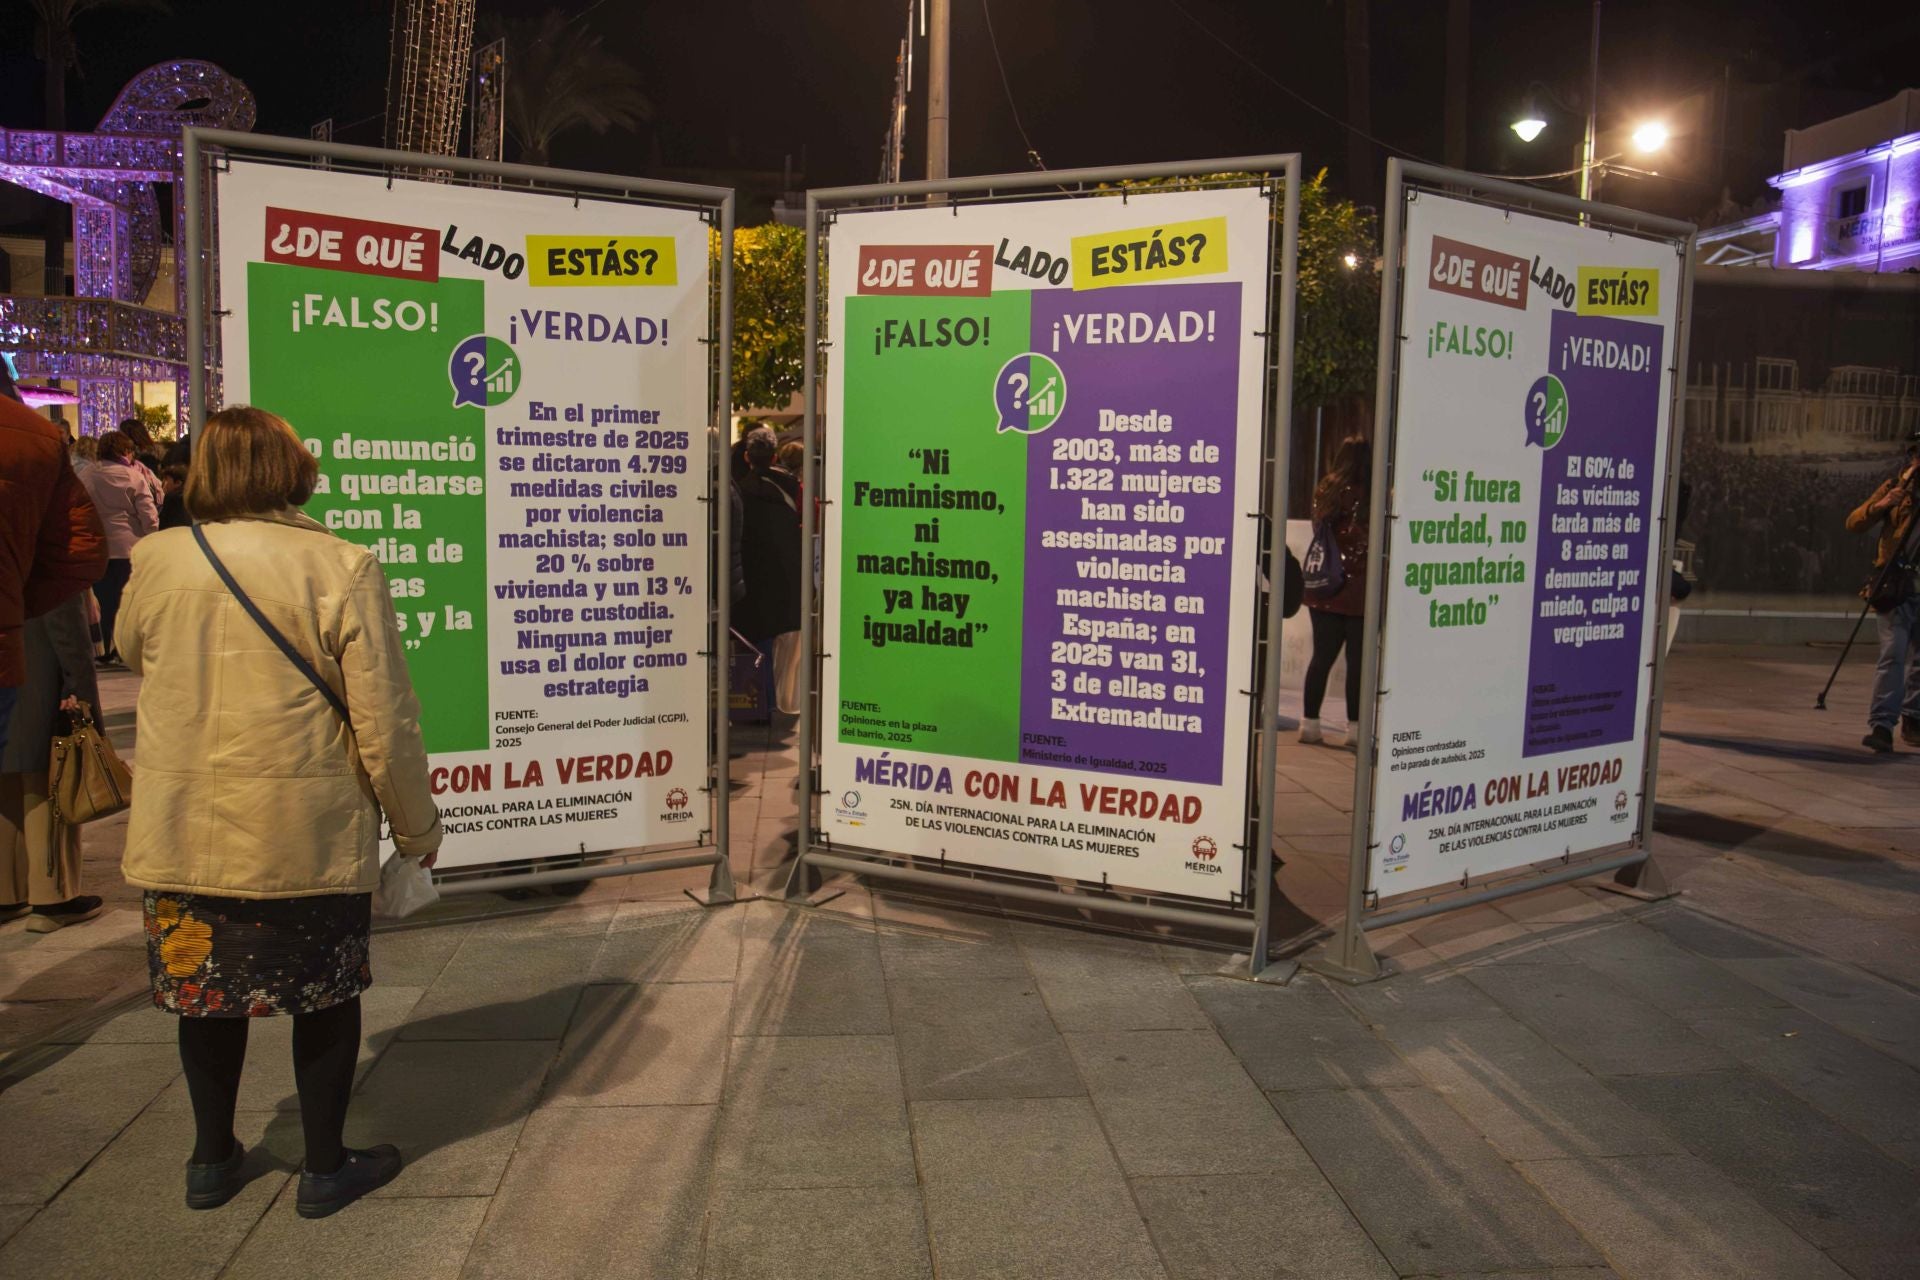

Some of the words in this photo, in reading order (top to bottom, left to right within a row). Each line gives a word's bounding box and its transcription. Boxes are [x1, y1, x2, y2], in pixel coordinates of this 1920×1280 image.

[271, 223, 343, 261] ¿DE
[356, 232, 424, 272] QUÉ
[441, 224, 524, 280] LADO
[548, 240, 658, 276] ESTÁS?
[862, 259, 916, 287] ¿DE
[925, 250, 980, 288] QUÉ
[994, 237, 1069, 286] LADO
[1091, 229, 1207, 277] ESTÁS?
[1433, 252, 1476, 289] ¿DE
[1481, 262, 1521, 300] QUÉ
[1530, 255, 1576, 309] LADO
[1588, 271, 1649, 306] ESTÁS?
[292, 294, 438, 332] ¡FALSO!
[510, 309, 668, 346] ¡VERDAD!
[875, 317, 990, 355] ¡FALSO!
[1053, 310, 1215, 352] ¡VERDAD!
[1428, 321, 1513, 360] ¡FALSO!
[1562, 336, 1651, 373] ¡VERDAD!
[529, 401, 557, 421] En
[564, 403, 584, 422] el
[591, 404, 660, 427] primer
[1098, 409, 1172, 432] Desde
[333, 432, 476, 461] denunció
[496, 426, 597, 448] trimestre
[603, 429, 629, 448] de
[635, 430, 689, 450] 2025
[1052, 438, 1121, 464] 2003,
[1129, 439, 1181, 462] más
[1189, 440, 1219, 463] de
[499, 456, 525, 472] se
[532, 452, 621, 473] dictaron
[627, 454, 687, 474] 4.799
[909, 448, 950, 475] “Ni
[1566, 455, 1582, 478] El
[1584, 456, 1615, 479] 60%
[1618, 458, 1635, 480] de
[341, 469, 484, 502] quedarse
[510, 478, 603, 498] medidas
[610, 479, 678, 499] civiles
[1050, 467, 1114, 491] 1.322
[1121, 469, 1221, 498] mujeres
[1422, 470, 1458, 502] “Si
[1464, 471, 1521, 503] fuera
[1556, 483, 1579, 506] las
[1582, 484, 1640, 506] víctimas
[854, 481, 1004, 515] Feminismo,
[1081, 497, 1126, 521] han
[1133, 499, 1185, 523] sido
[325, 508, 384, 531] con
[393, 503, 422, 529] la
[526, 508, 561, 527] por
[568, 504, 664, 523] violencia
[1552, 512, 1589, 534] tarda
[1592, 512, 1622, 533] más
[1624, 512, 1641, 533] de
[498, 528, 606, 550] machista;
[613, 528, 656, 547] solo
[662, 532, 688, 547] un
[914, 517, 939, 543] ni
[1041, 527, 1177, 553] asesinadas
[1184, 536, 1225, 559] por
[1409, 513, 1492, 548] verdad,
[1500, 520, 1527, 543] no
[536, 554, 565, 573] 20
[572, 554, 591, 573] %
[597, 554, 654, 572] sobre
[1561, 539, 1572, 561] 8
[1575, 540, 1609, 560] años
[1612, 544, 1629, 560] en
[856, 551, 998, 584] machismo,
[1076, 556, 1186, 583] violencia
[1404, 553, 1525, 594] aguantaría
[1545, 566, 1615, 589] denunciar
[1617, 570, 1640, 591] por
[494, 579, 588, 599] vivienda
[594, 583, 607, 601] y
[613, 582, 640, 596] un
[647, 576, 668, 596] 13
[674, 576, 692, 595] %
[883, 589, 913, 614] ya
[921, 585, 970, 619] hay
[1056, 586, 1166, 612] machista
[1174, 595, 1204, 614] en
[514, 604, 574, 624] sobre
[581, 601, 674, 622] custodia.
[1429, 594, 1499, 628] tanto”
[1540, 594, 1587, 618] miedo,
[1591, 592, 1628, 618] culpa
[1631, 596, 1640, 612] o
[517, 630, 607, 653] Ninguna
[614, 625, 673, 649] mujer
[863, 615, 988, 648] igualdad”
[1062, 613, 1157, 644] España;
[1165, 625, 1196, 644] en
[1554, 620, 1624, 648] vergüenza
[500, 659, 541, 675] usa
[547, 654, 567, 673] el
[574, 652, 626, 672] dolor
[633, 652, 687, 669] como
[1051, 641, 1112, 667] 2025
[1119, 651, 1164, 671] van
[1171, 649, 1205, 678] 31,
[544, 674, 649, 698] estrategia
[1051, 669, 1067, 692] 3
[1073, 671, 1101, 695] de
[1108, 675, 1166, 700] ellas
[1173, 685, 1204, 704] en
[495, 709, 538, 721] FUENTE:
[841, 700, 881, 713] FUENTE:
[1051, 697, 1202, 733] Extremadura
[495, 723, 535, 735] Consejo
[537, 720, 575, 732] General
[576, 720, 592, 729] del
[593, 718, 621, 728] Poder
[623, 715, 656, 726] Judicial
[657, 712, 689, 724] (CGPJ),
[841, 714, 887, 727] Opiniones
[901, 720, 911, 730] la
[912, 722, 938, 733] plaza
[1392, 730, 1422, 743] FUENTE:
[496, 737, 522, 748] 2025
[1391, 746, 1425, 759] Opiniones
[1426, 739, 1466, 752] contrastadas
[430, 764, 492, 795] CON
[504, 760, 544, 790] LA
[556, 749, 673, 784] VERDAD
[855, 751, 953, 795] MÉRIDA
[964, 770, 1019, 803] CON
[1030, 777, 1067, 809] LA
[1080, 783, 1202, 824] VERDAD
[1402, 781, 1476, 822] MÉRIDA
[1484, 775, 1522, 806] CON
[1526, 770, 1549, 799] LA
[1557, 758, 1622, 793] VERDAD
[660, 811, 693, 821] MÉRIDA
[890, 798, 913, 811] 25N.
[915, 800, 934, 814] DÍA
[936, 804, 1025, 826] INTERNACIONAL
[1027, 816, 1057, 830] PARA
[1060, 821, 1075, 833] LA
[1077, 823, 1155, 843] ELIMINACIÓN
[905, 816, 920, 827] DE
[922, 818, 942, 831] LAS
[944, 821, 1010, 840] VIOLENCIAS
[1012, 830, 1059, 847] CONTRA
[1061, 838, 1084, 850] LAS
[1086, 841, 1140, 858] MUJERES
[1185, 861, 1222, 874] MÉRIDA
